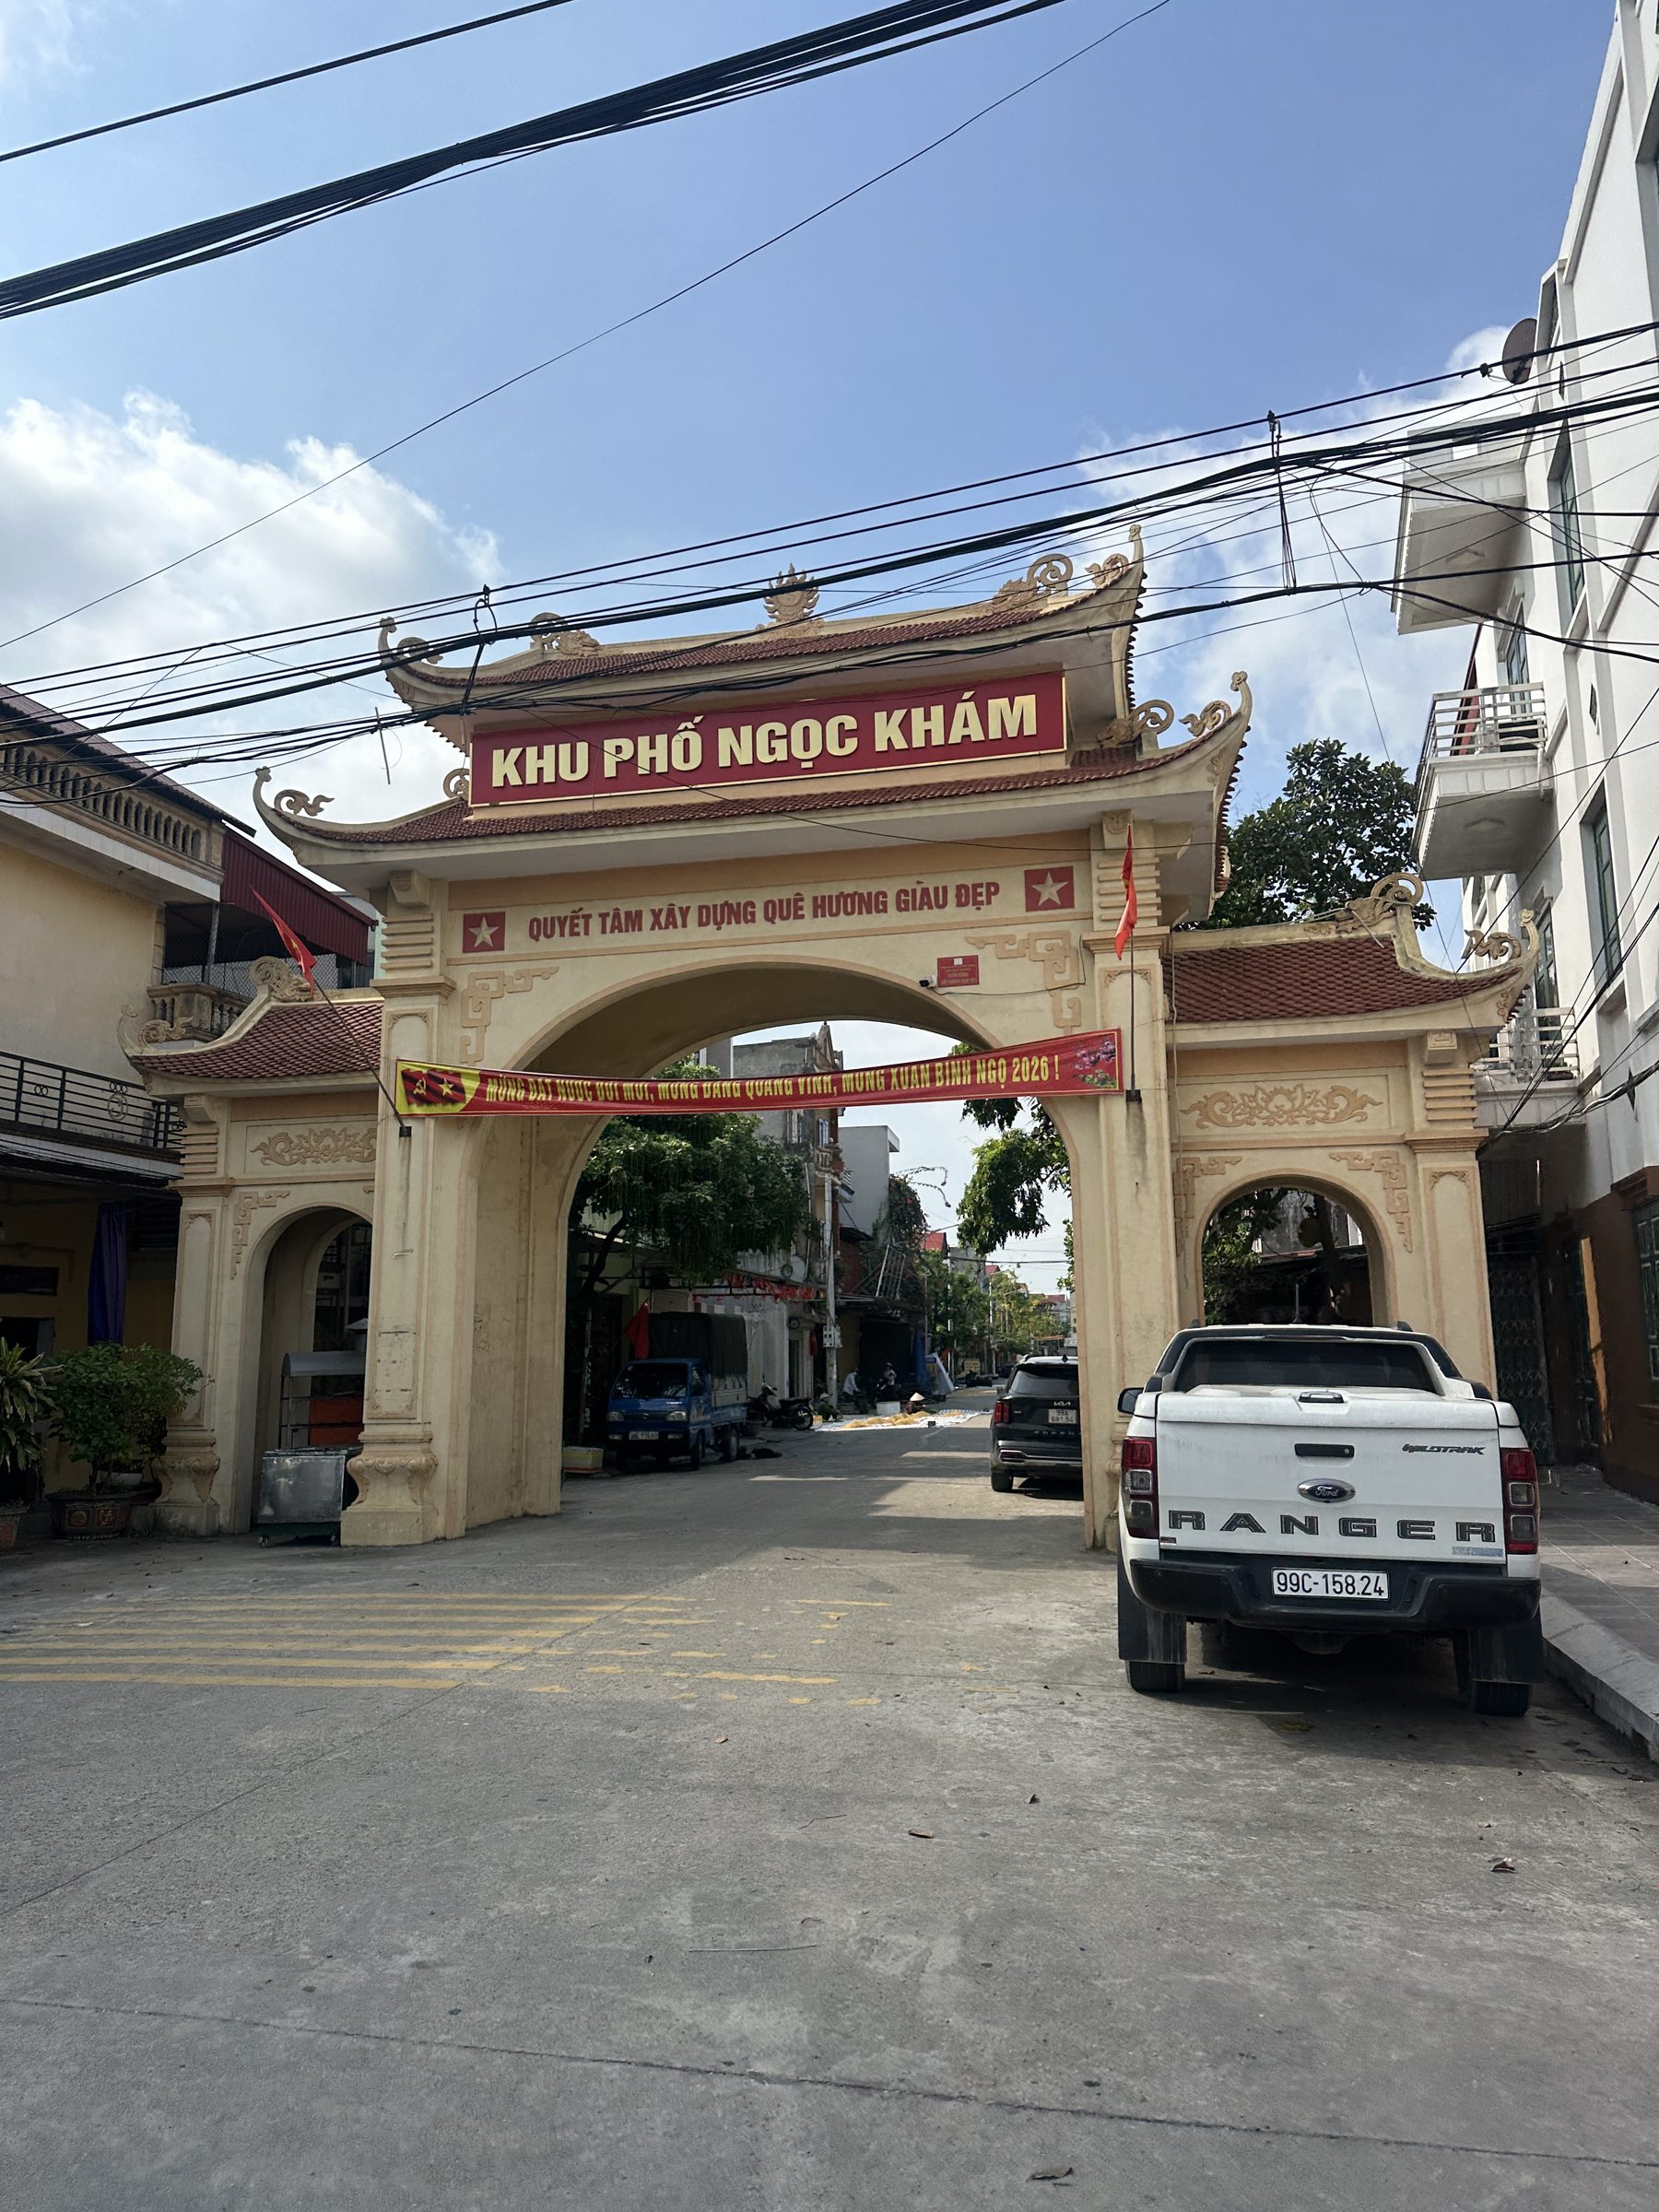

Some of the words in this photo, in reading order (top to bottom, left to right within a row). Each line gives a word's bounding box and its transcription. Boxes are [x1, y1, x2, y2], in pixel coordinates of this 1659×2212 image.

[491, 740, 589, 788] KHU
[603, 715, 704, 778] PHỐ
[717, 714, 859, 769] NGỌC
[874, 691, 1038, 752] KHÁM
[528, 907, 593, 942] QUYẾT
[598, 907, 643, 935] TÂM
[650, 902, 691, 931] XÂY
[697, 900, 757, 931] DỰNG
[763, 892, 806, 924] QUÊ
[812, 890, 888, 918] HƯƠNG
[895, 880, 948, 912] GIÀU
[955, 881, 1000, 911] ĐẸP
[976, 1057, 1006, 1089] NGỌ
[1012, 1055, 1049, 1082] 2026
[1402, 1443, 1487, 1455] WILDTRAK
[1314, 1485, 1340, 1497] Ford
[1168, 1510, 1496, 1543] RANGER
[1277, 1571, 1384, 1596] 99C-158.24
